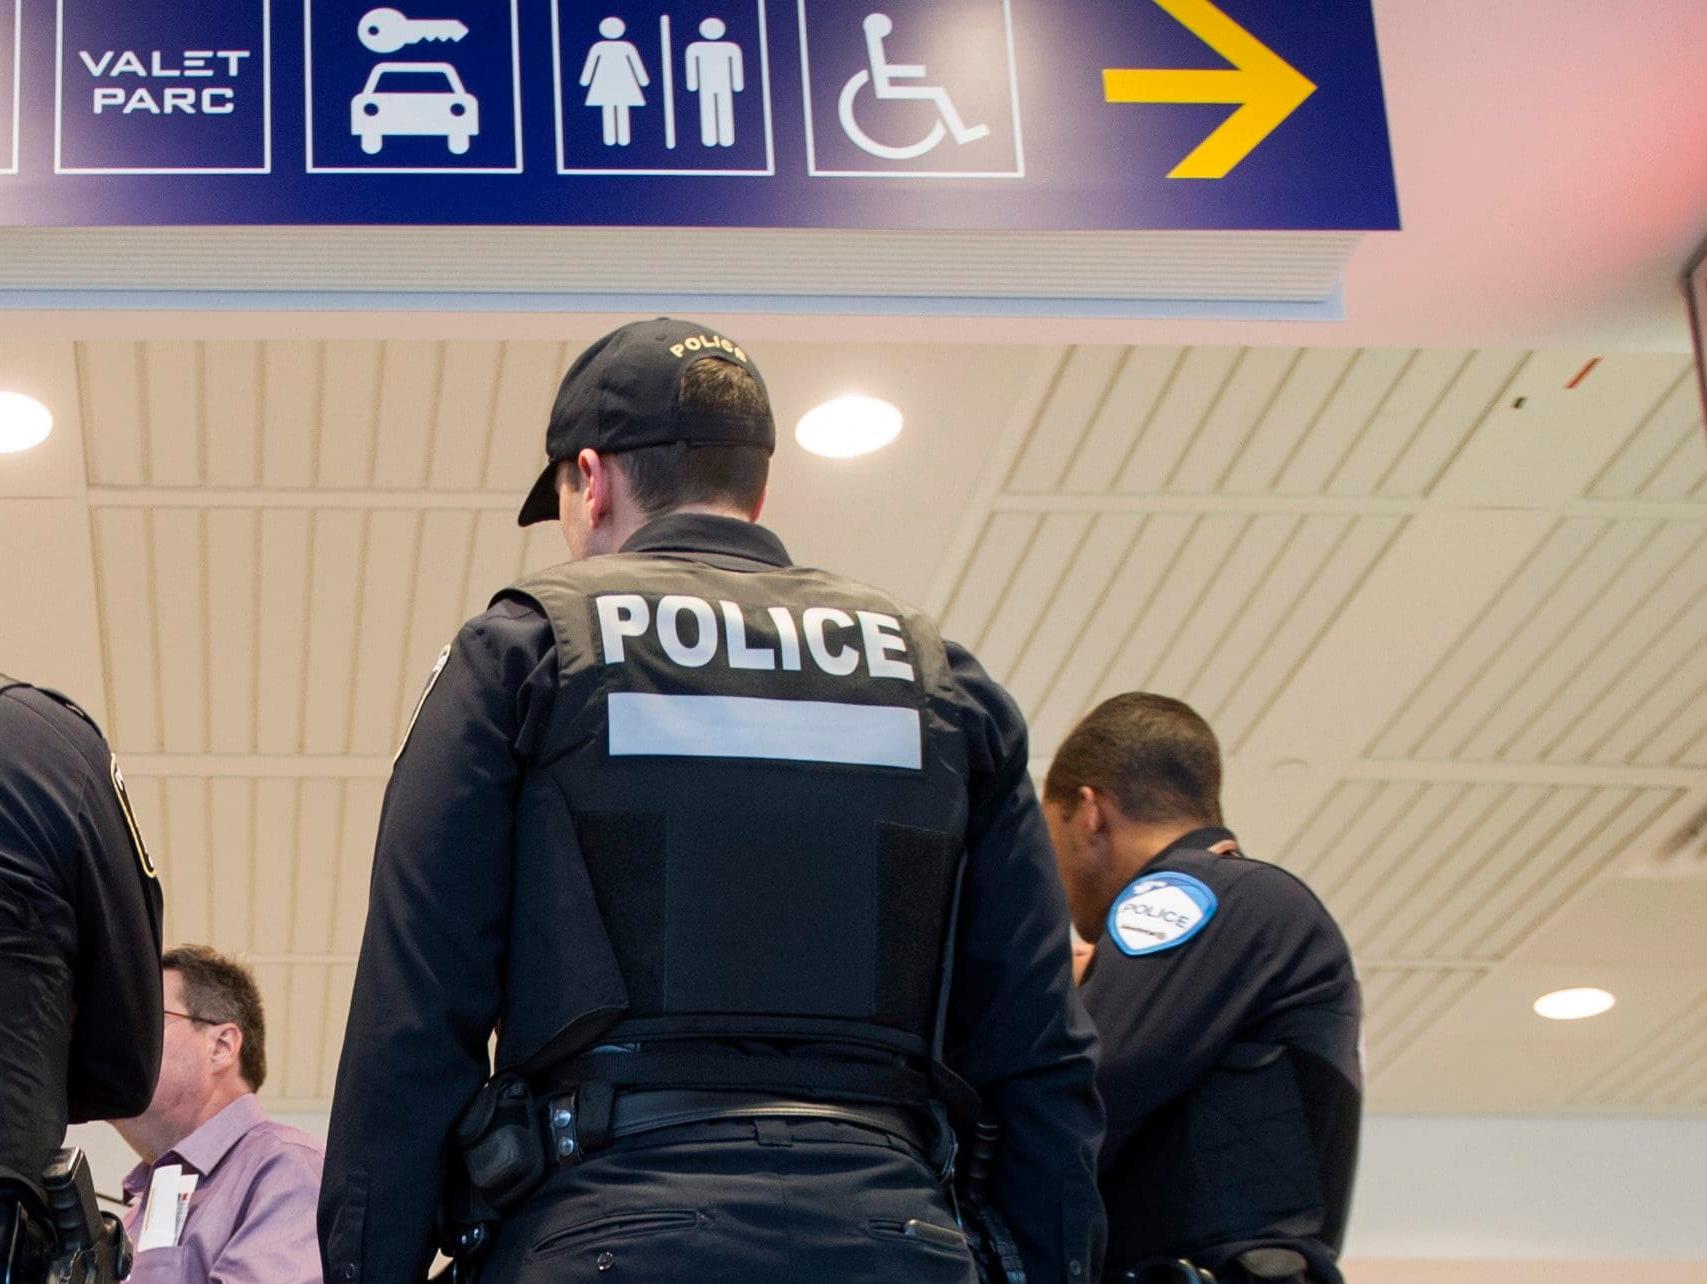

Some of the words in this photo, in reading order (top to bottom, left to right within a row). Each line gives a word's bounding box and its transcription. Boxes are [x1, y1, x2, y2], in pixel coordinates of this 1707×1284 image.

[78, 51, 251, 78] VALET
[92, 87, 235, 115] PARC
[596, 595, 915, 681] POLICE
[1122, 903, 1190, 928] POLICE
